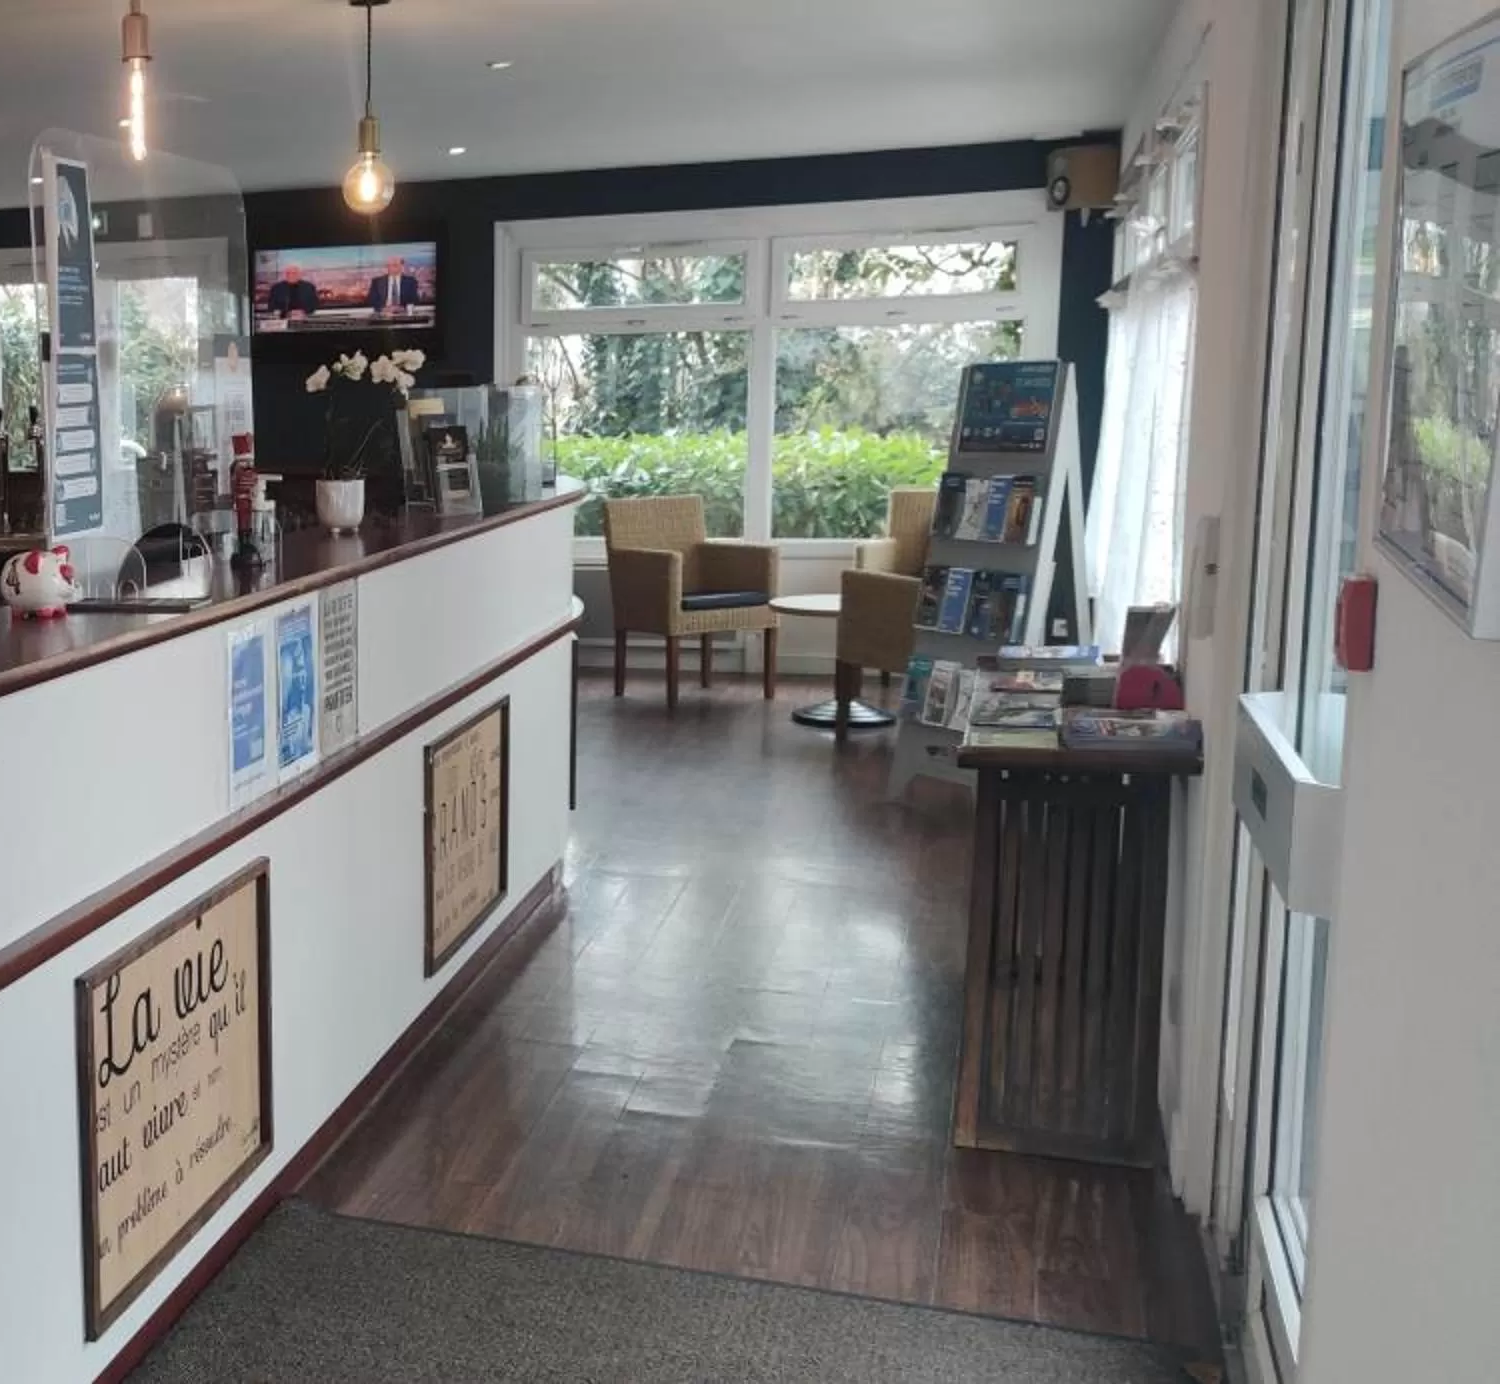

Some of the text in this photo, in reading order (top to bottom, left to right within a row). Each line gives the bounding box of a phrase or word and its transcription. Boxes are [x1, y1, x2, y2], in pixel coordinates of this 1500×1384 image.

[98, 917, 229, 1089] La vie
[123, 1079, 142, 1115] un
[151, 1021, 201, 1083] mystère
[99, 1135, 133, 1193] aut
[143, 1091, 189, 1150] vivre
[175, 1157, 184, 1185] à
